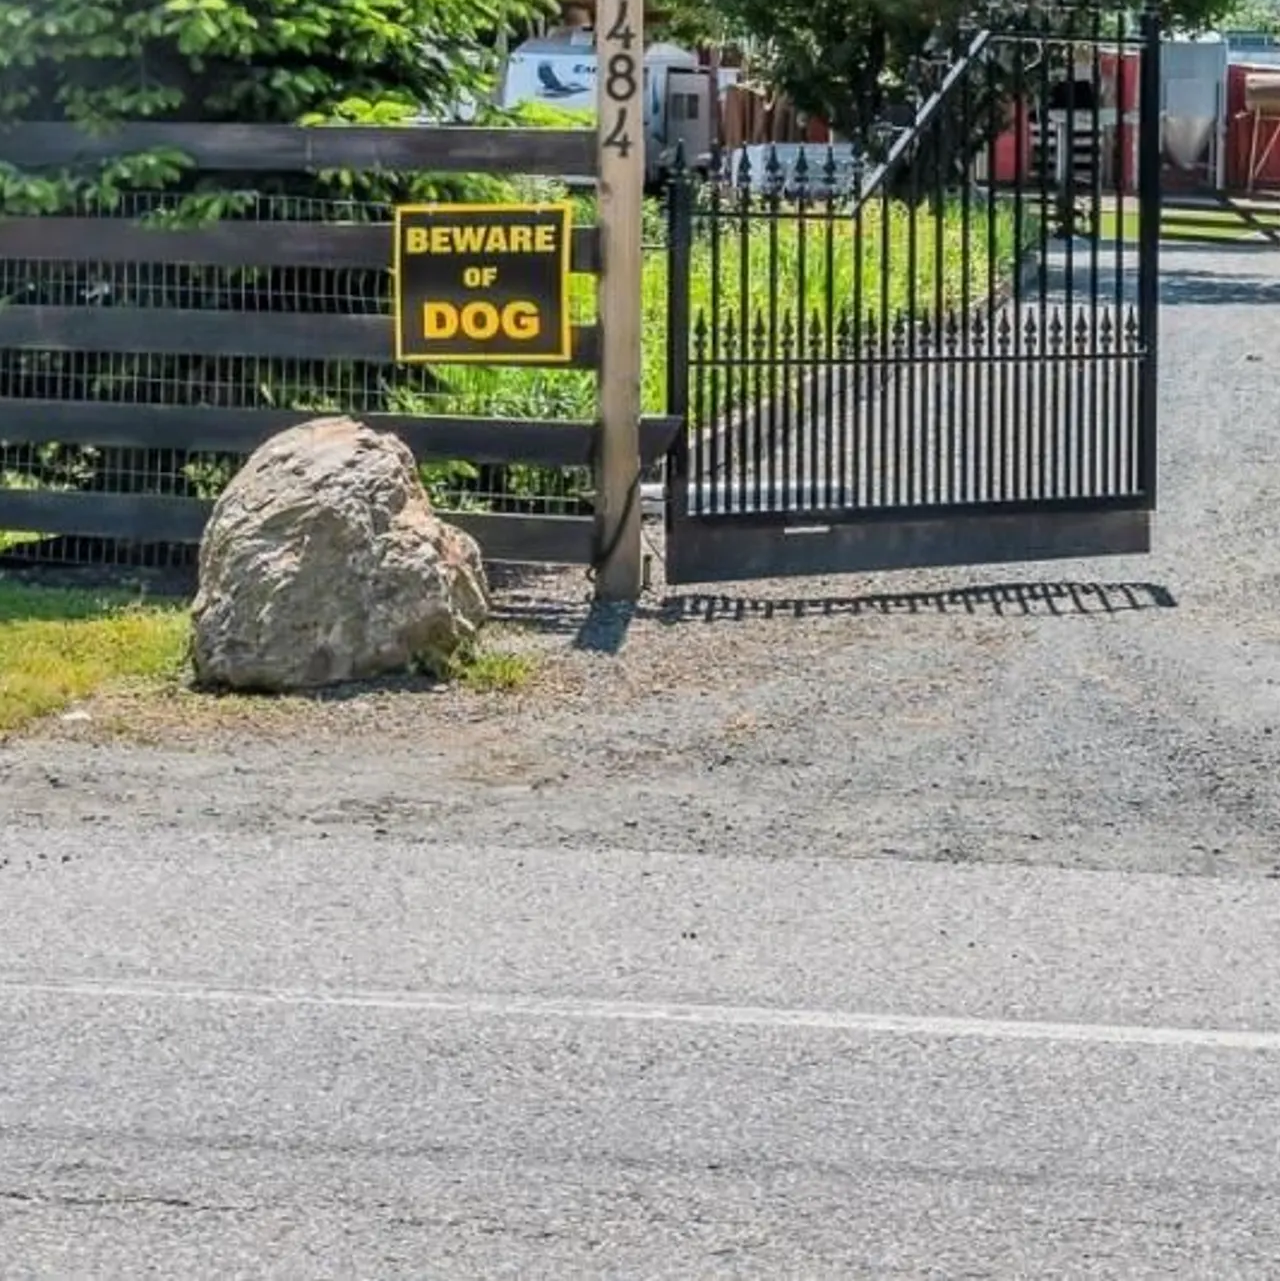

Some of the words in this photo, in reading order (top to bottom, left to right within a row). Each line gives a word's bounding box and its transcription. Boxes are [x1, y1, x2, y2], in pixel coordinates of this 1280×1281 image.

[406, 225, 556, 254] BEWARE
[464, 267, 498, 287] OF
[423, 301, 541, 340] DOG
